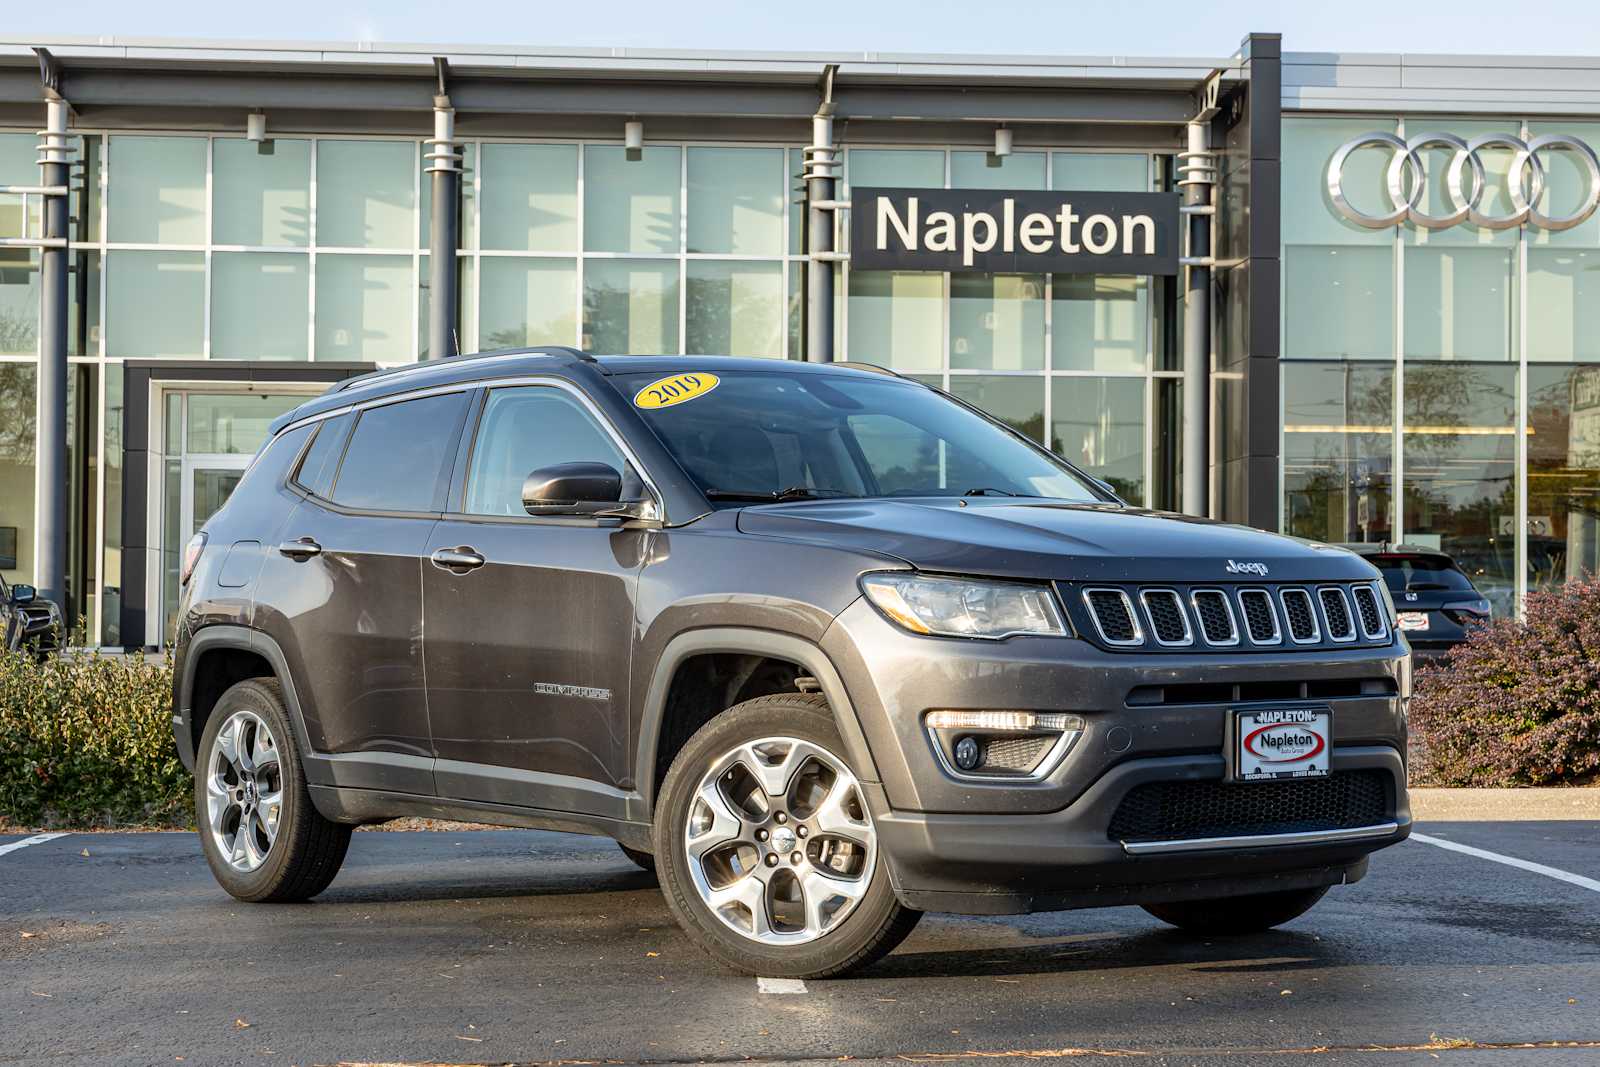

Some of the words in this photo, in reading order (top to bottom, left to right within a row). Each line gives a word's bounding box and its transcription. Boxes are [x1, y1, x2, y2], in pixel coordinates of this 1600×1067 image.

[876, 196, 1156, 266] Napleton
[648, 375, 701, 404] 2019
[1226, 559, 1269, 577] Jeep
[1259, 711, 1312, 722] NAPLETON
[1261, 733, 1312, 749] Napleton
